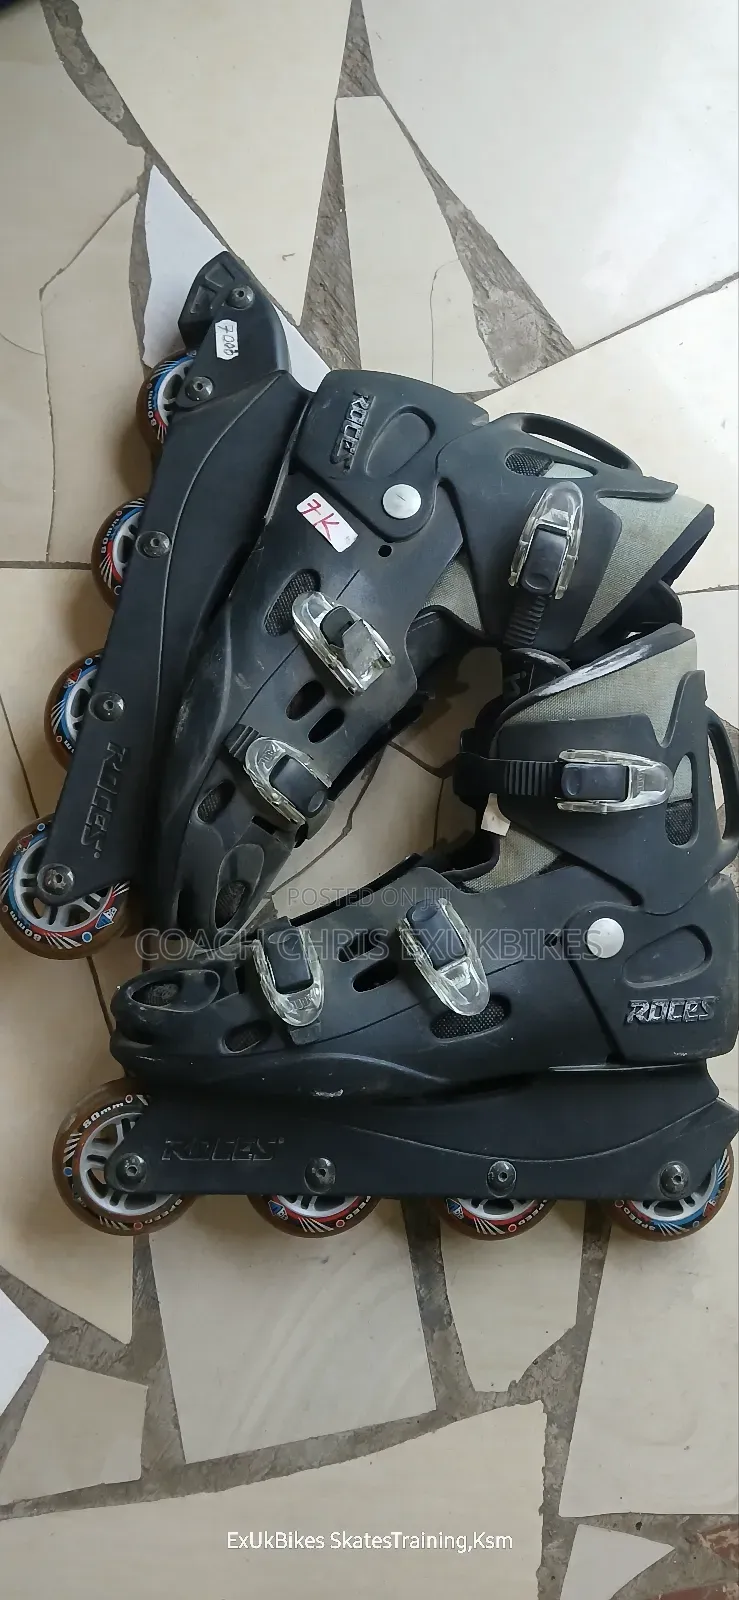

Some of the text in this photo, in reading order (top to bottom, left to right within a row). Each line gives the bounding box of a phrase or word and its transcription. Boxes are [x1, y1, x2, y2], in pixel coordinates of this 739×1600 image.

[217, 324, 236, 356] 7000
[147, 390, 157, 427] 80mm
[301, 498, 340, 541] 7K
[9, 910, 42, 943] 80mm
[82, 1102, 124, 1129] 80mm
[144, 1198, 183, 1224] SPEED
[345, 1195, 371, 1220] PEED
[623, 1207, 656, 1231] SPEED
